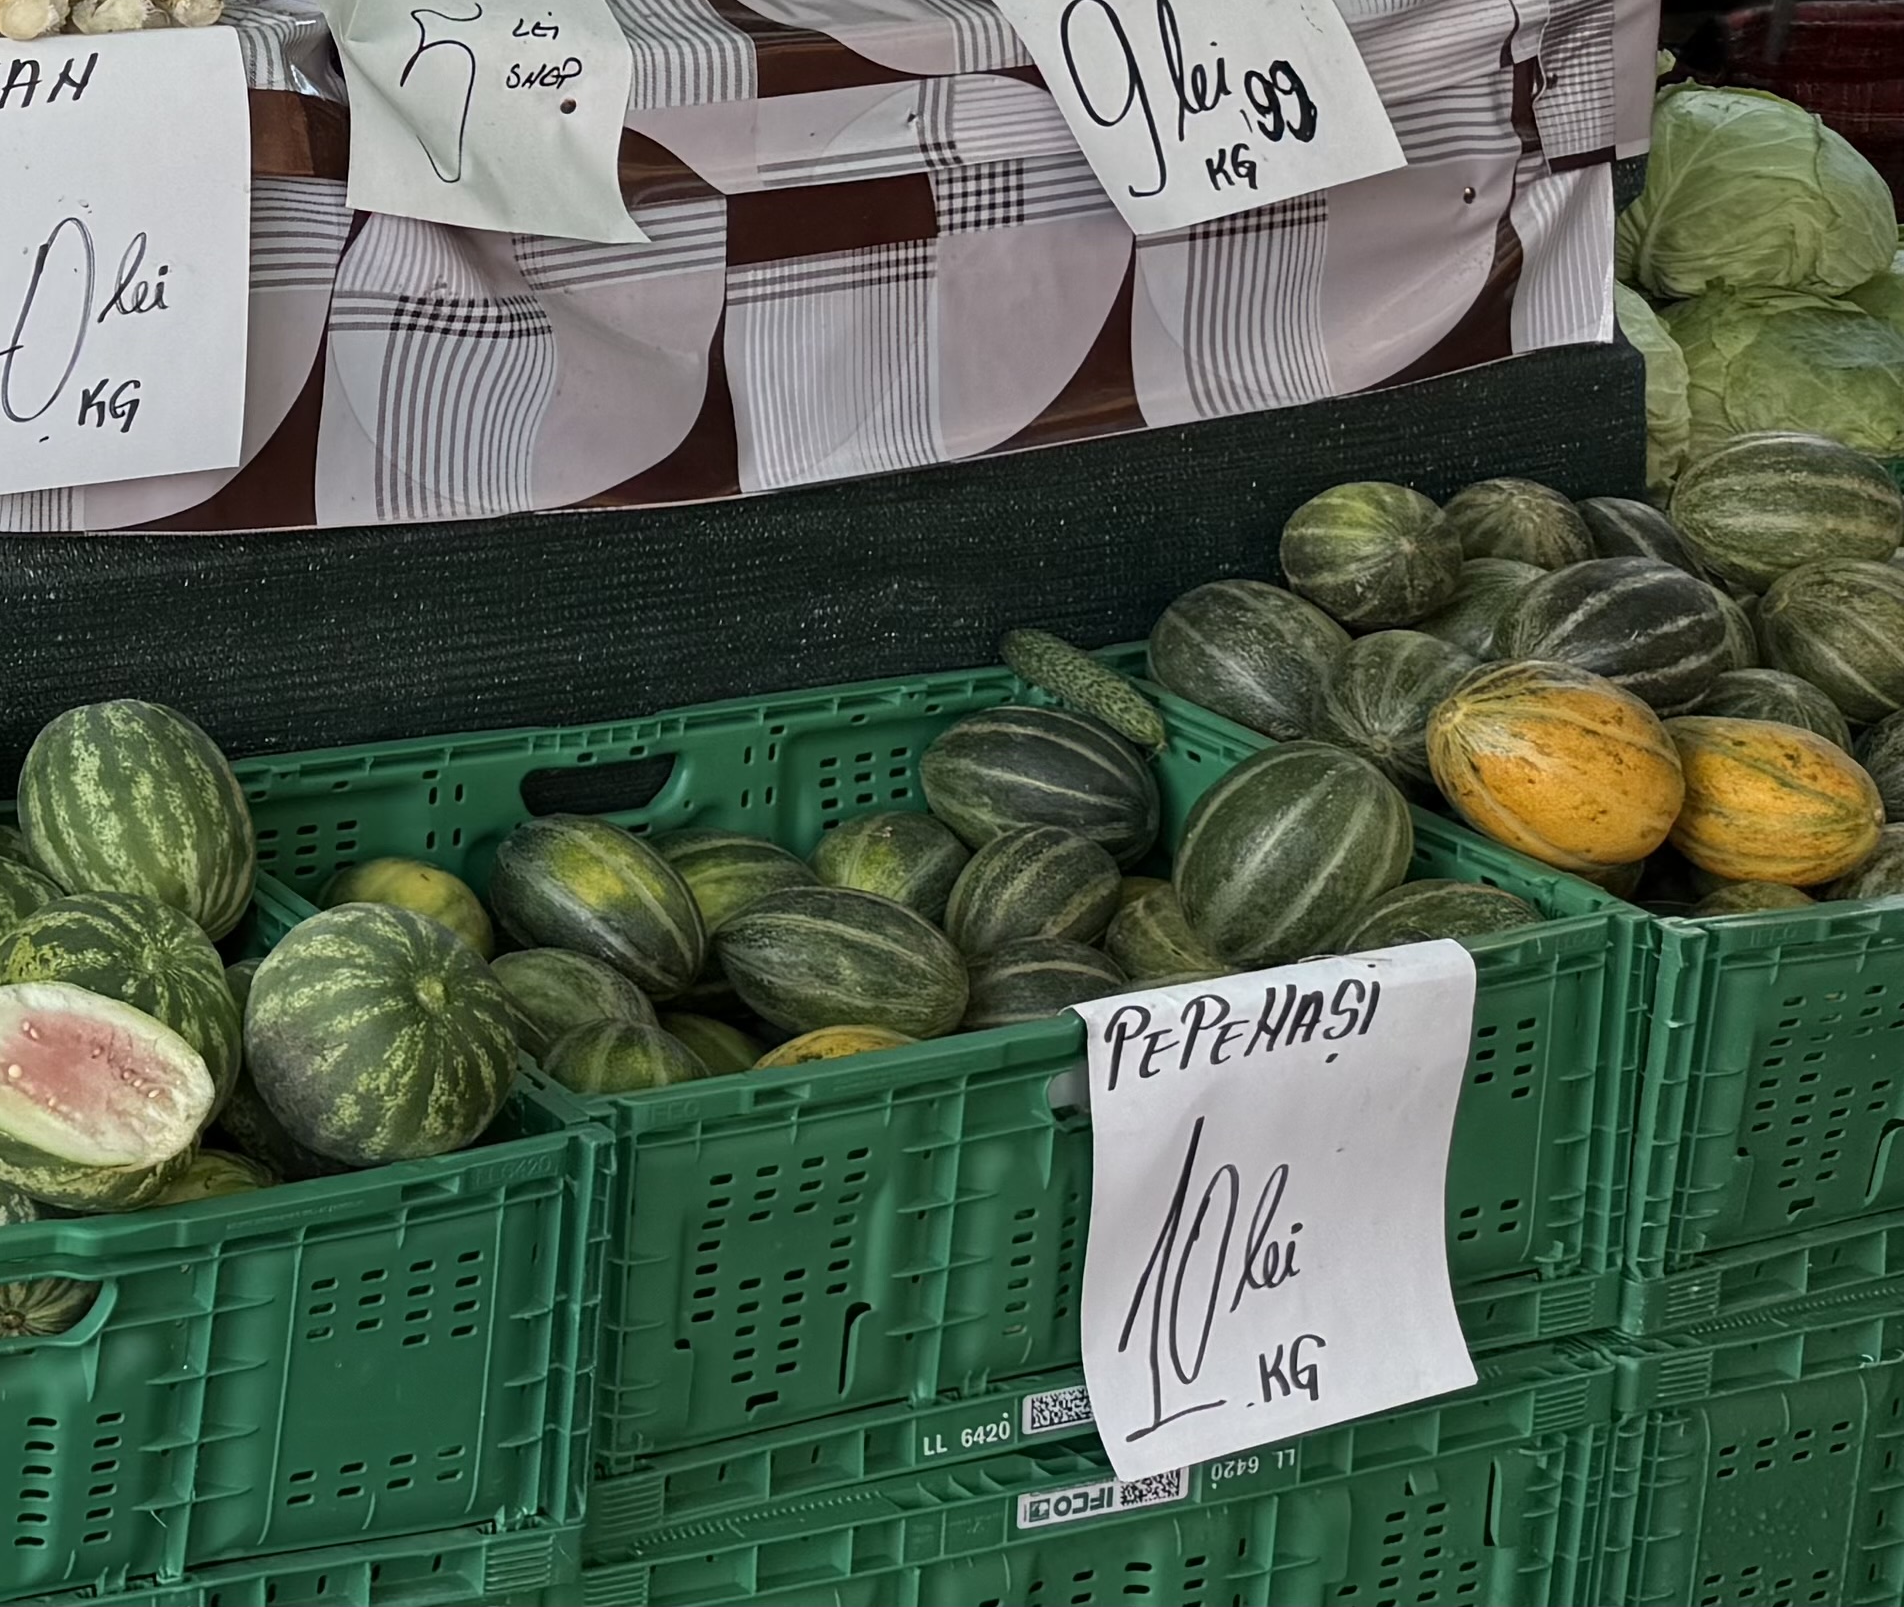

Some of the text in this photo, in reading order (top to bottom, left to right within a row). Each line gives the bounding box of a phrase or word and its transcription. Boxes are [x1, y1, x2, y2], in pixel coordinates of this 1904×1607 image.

[1205, 143, 1258, 190] KG
[97, 231, 170, 323] lei
[77, 378, 141, 433] KG
[1118, 1115, 1304, 1443] 10 lei
[1258, 1334, 1327, 1402] KG
[923, 1421, 1011, 1456] LL 6420
[1052, 1486, 1114, 1518] IFCO
